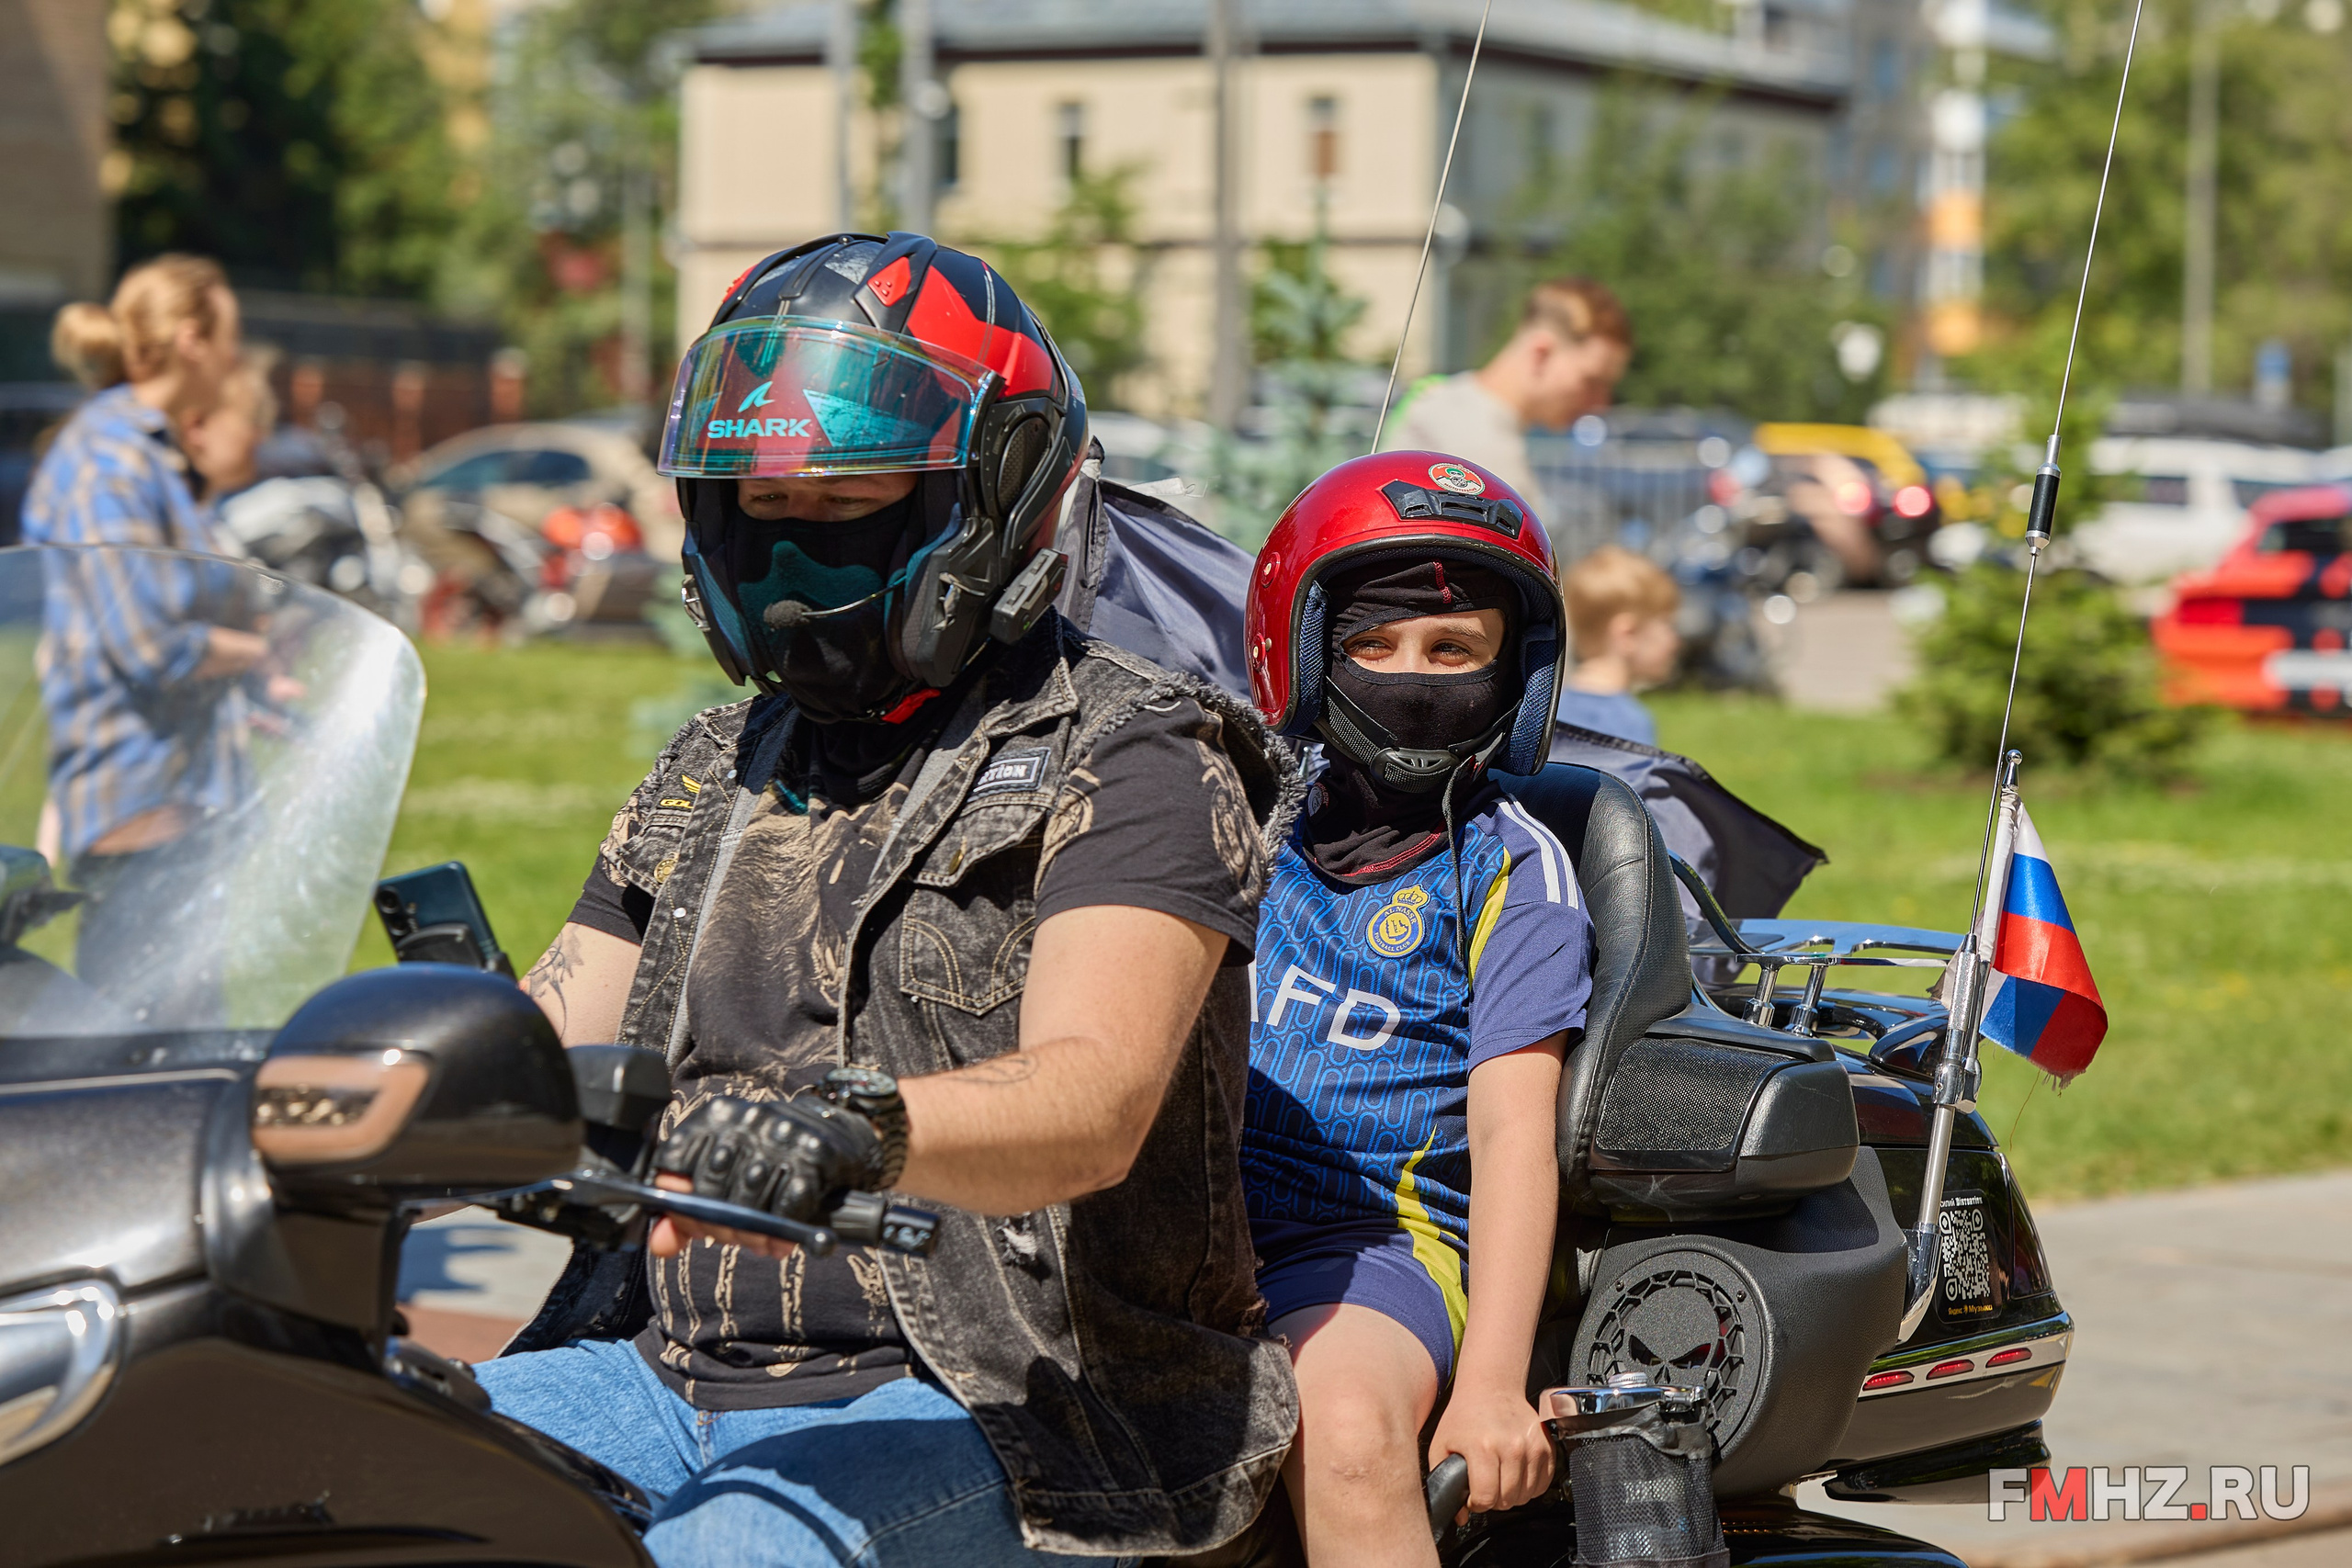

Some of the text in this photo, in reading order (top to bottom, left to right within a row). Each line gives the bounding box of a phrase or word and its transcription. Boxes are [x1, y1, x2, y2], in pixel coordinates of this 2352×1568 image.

[707, 418, 811, 438] SHARK
[1385, 906, 1417, 924] AL NASSR
[1374, 931, 1411, 952] FOOTBALL CLUB
[1968, 1304, 1993, 1314] Музыка
